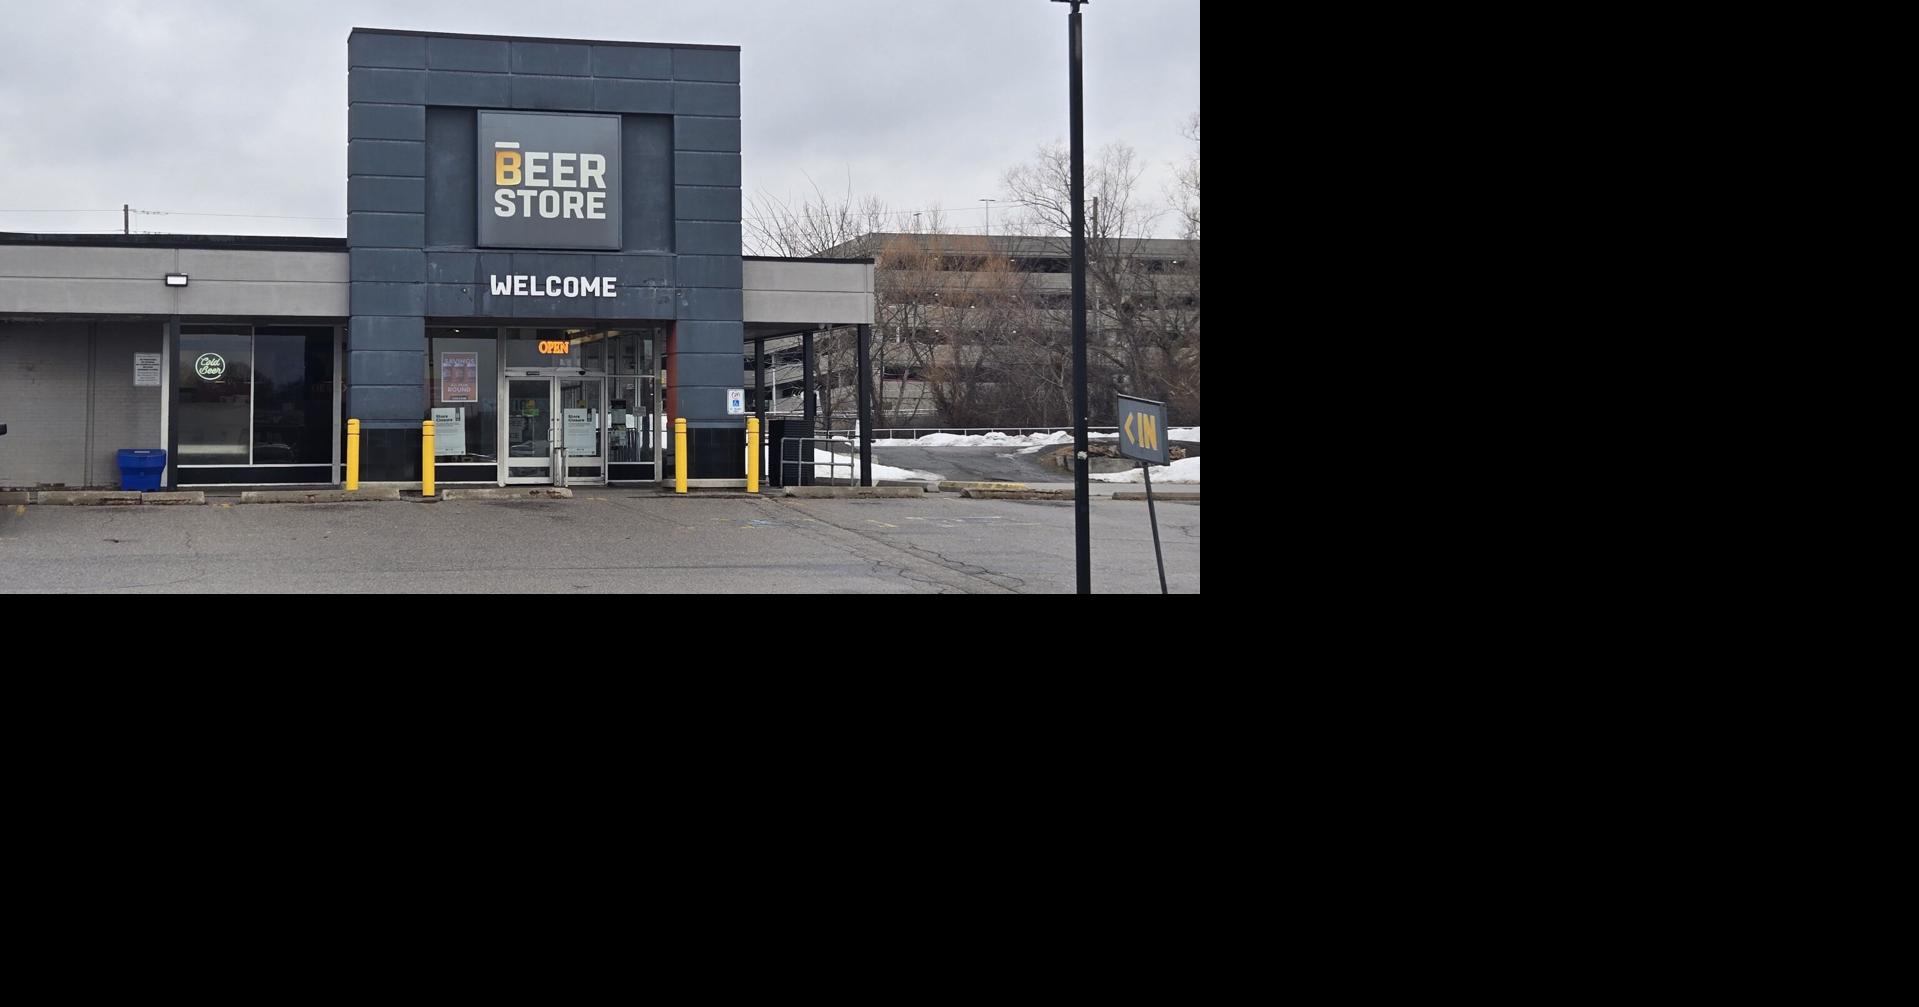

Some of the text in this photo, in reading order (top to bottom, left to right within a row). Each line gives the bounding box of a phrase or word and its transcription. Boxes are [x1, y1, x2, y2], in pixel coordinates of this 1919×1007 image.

[495, 150, 607, 188] BEER
[494, 188, 606, 219] STORE
[490, 275, 617, 297] WELCOME
[538, 341, 569, 354] OPEN
[199, 366, 221, 375] Beer
[200, 357, 221, 366] Cold
[1137, 412, 1157, 450] IN
